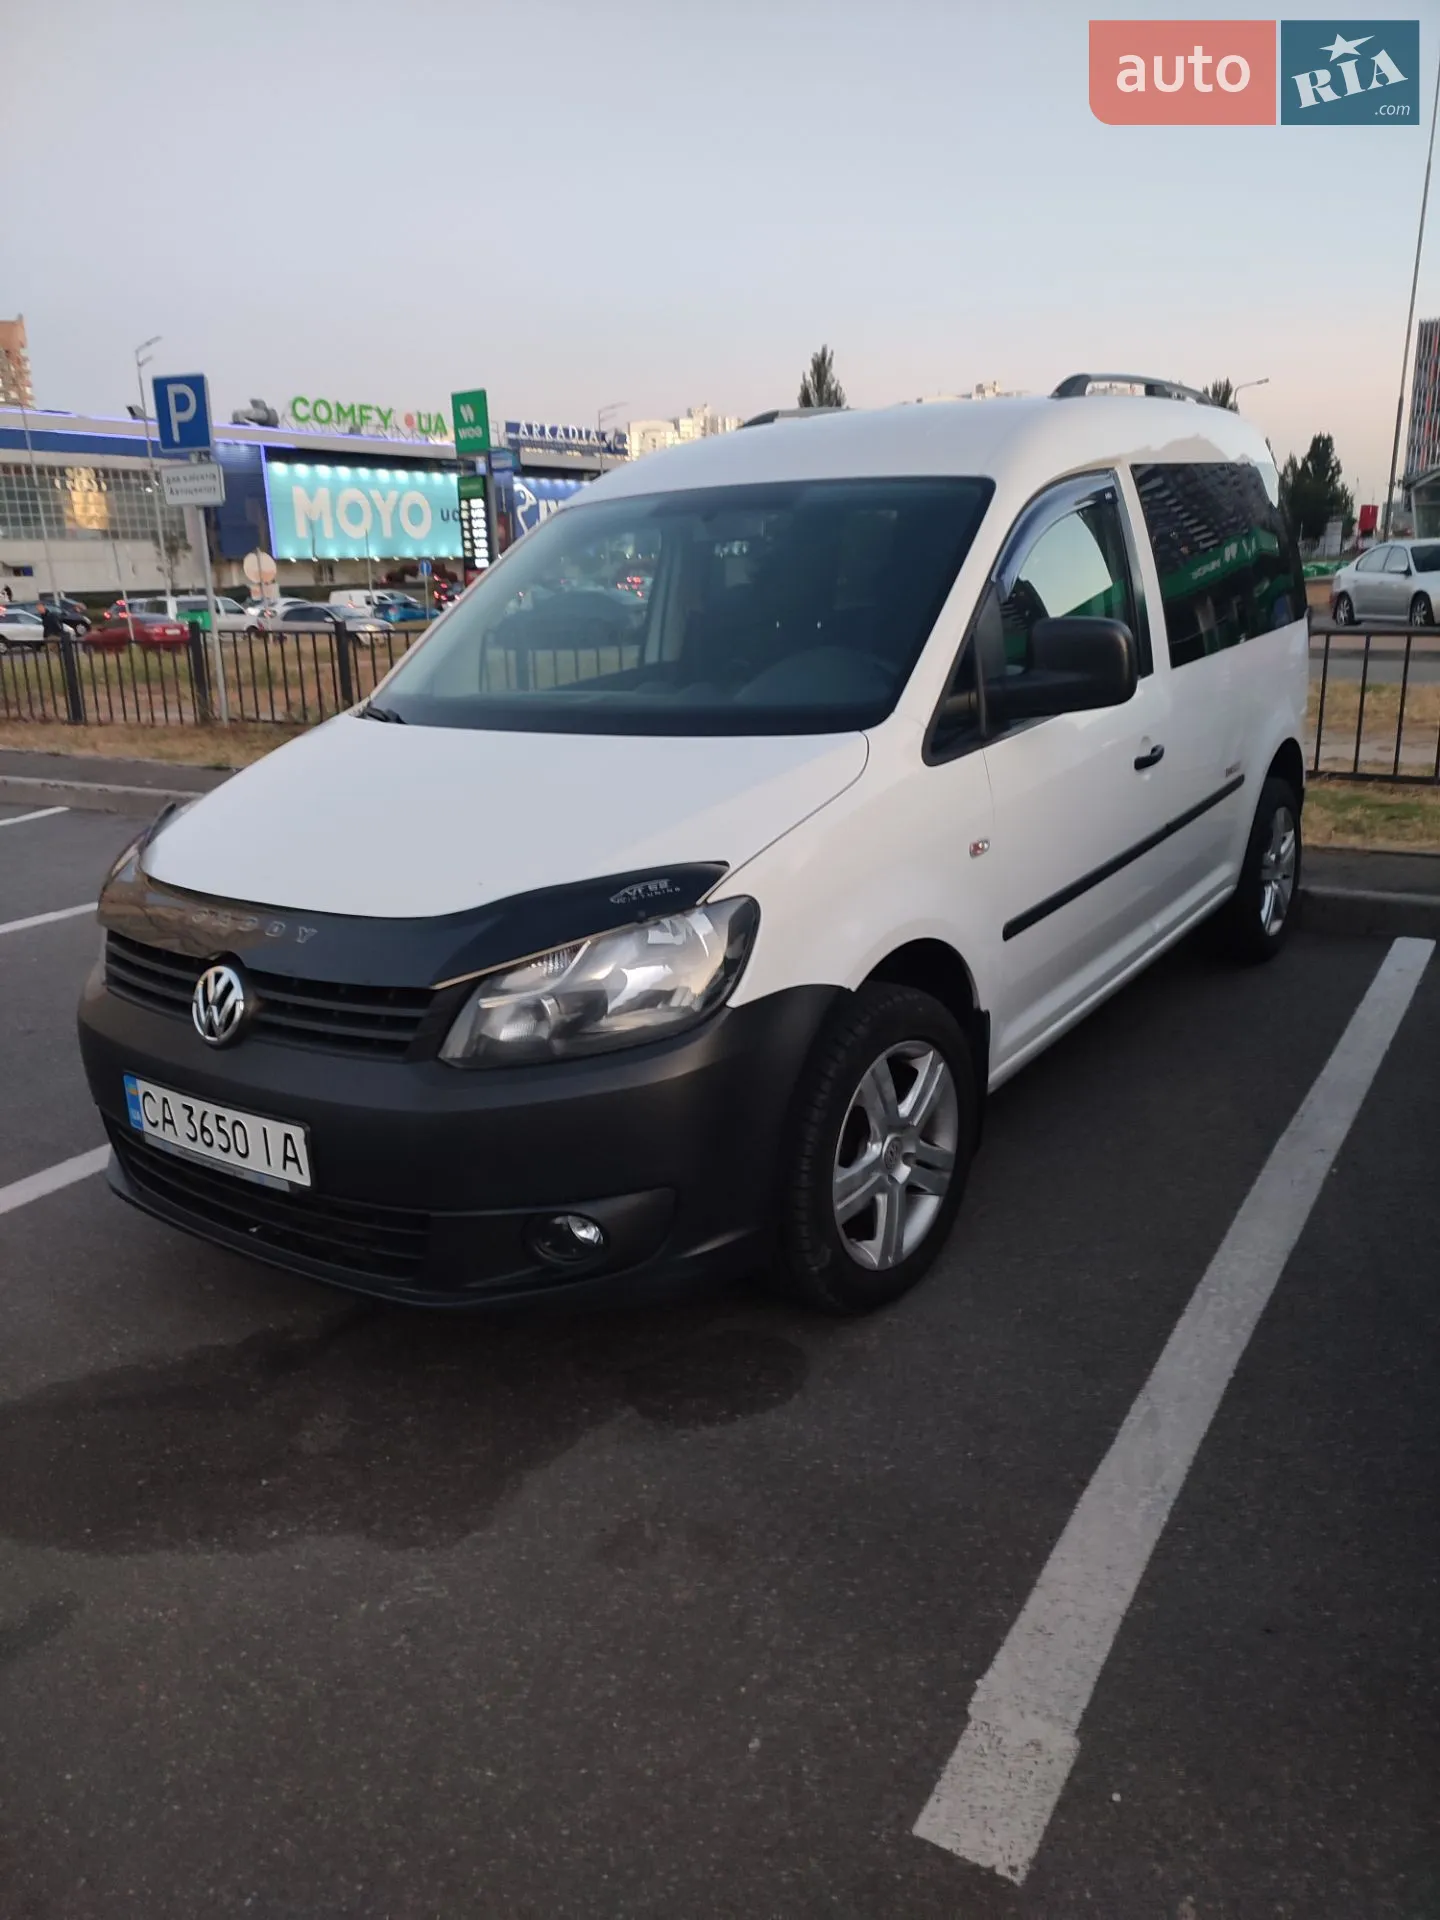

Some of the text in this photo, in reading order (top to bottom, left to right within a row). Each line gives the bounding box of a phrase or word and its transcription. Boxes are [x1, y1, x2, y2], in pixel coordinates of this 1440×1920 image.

[166, 383, 197, 443] P
[292, 396, 394, 431] COMFY
[519, 419, 602, 445] ARKADIA
[291, 485, 432, 540] MOYO
[142, 1090, 178, 1137] CA
[181, 1102, 250, 1159] 3650
[262, 1126, 304, 1176] IA
